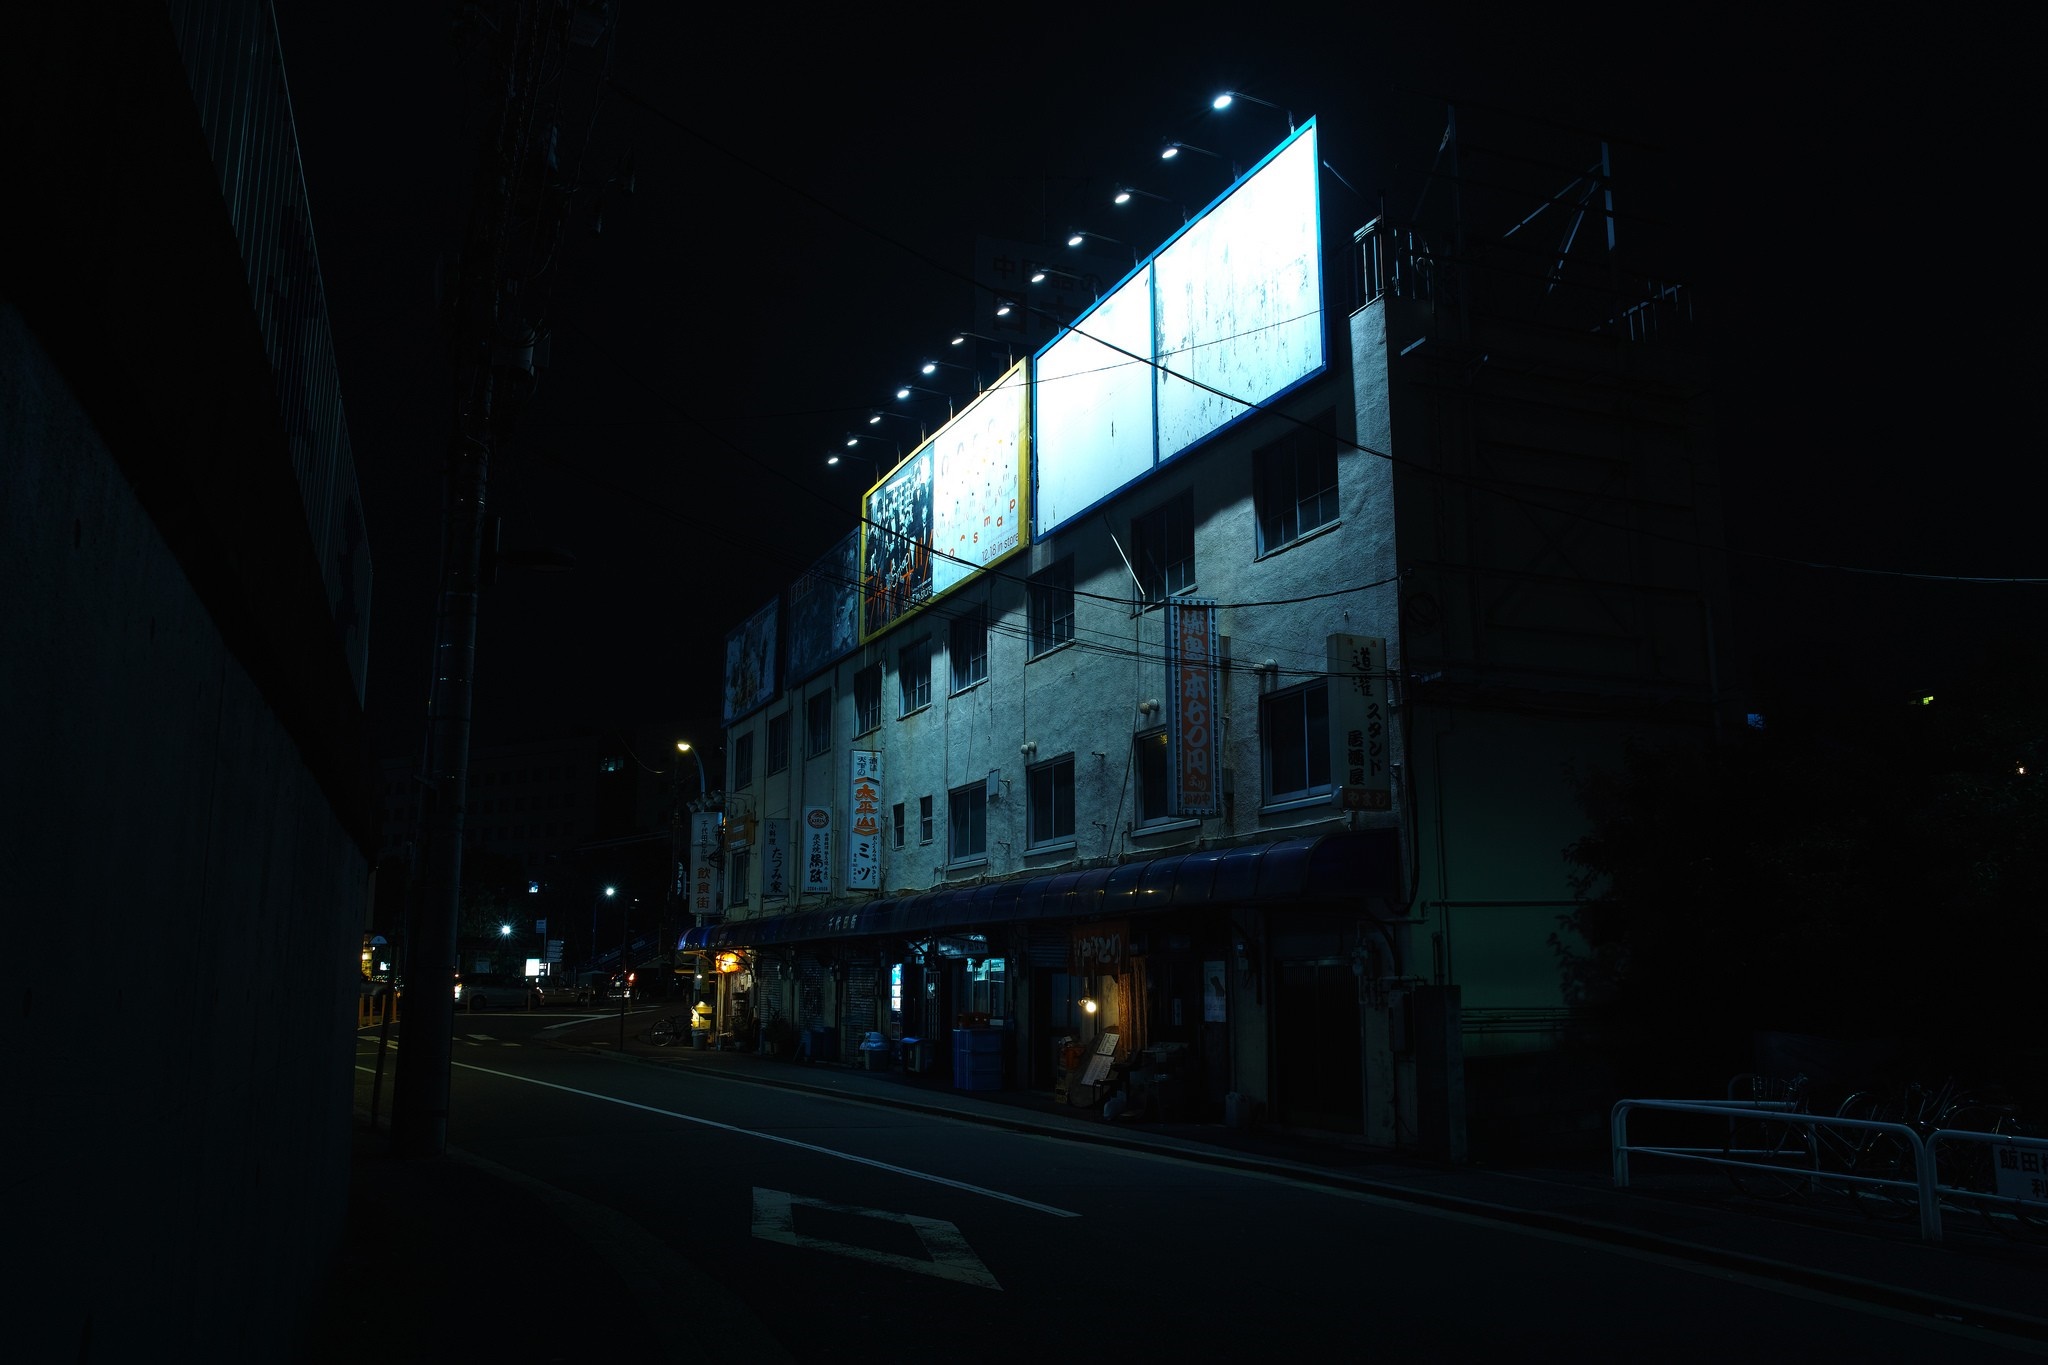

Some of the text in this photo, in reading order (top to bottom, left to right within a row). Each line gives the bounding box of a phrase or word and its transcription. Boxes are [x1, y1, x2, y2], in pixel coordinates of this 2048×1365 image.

[982, 543, 997, 563] 12.18
[997, 540, 1003, 553] in
[1348, 730, 1365, 786] 居酒屋
[1368, 703, 1382, 777] スタンド
[855, 784, 879, 828] 太平山
[768, 822, 777, 845] 小料理
[858, 843, 870, 880] ミツ
[697, 867, 711, 909] 飲食街
[2031, 1178, 2048, 1198] 利
